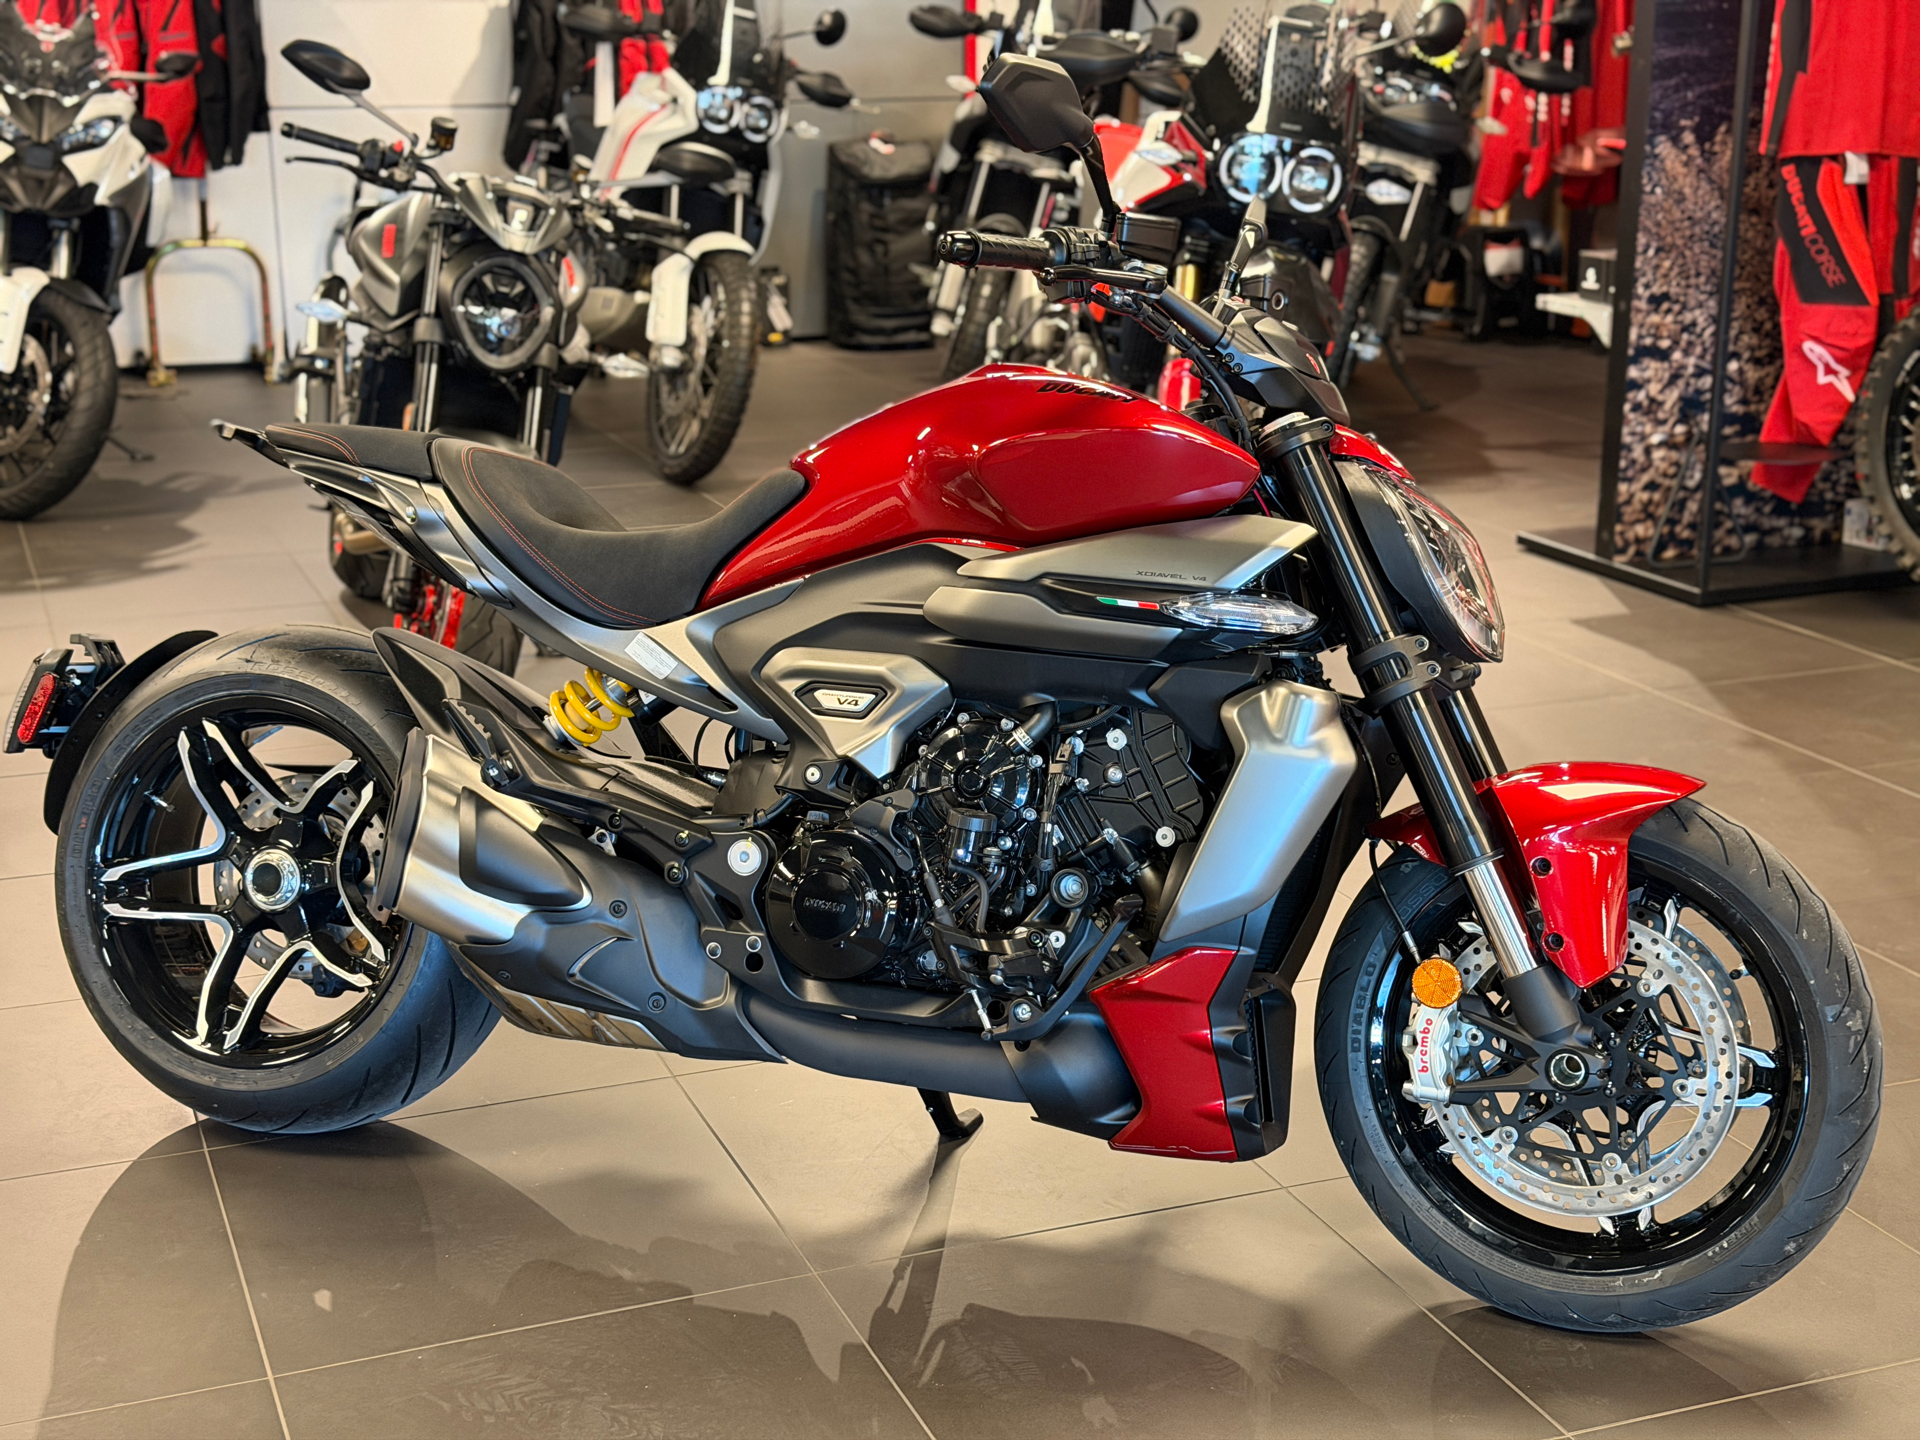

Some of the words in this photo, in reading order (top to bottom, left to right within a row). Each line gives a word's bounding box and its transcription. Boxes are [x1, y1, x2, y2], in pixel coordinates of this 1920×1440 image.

[1136, 570, 1188, 580] XDIAVEL
[837, 697, 860, 706] V4
[1350, 961, 1378, 1053] DIABLO
[1418, 1018, 1433, 1073] brembo
